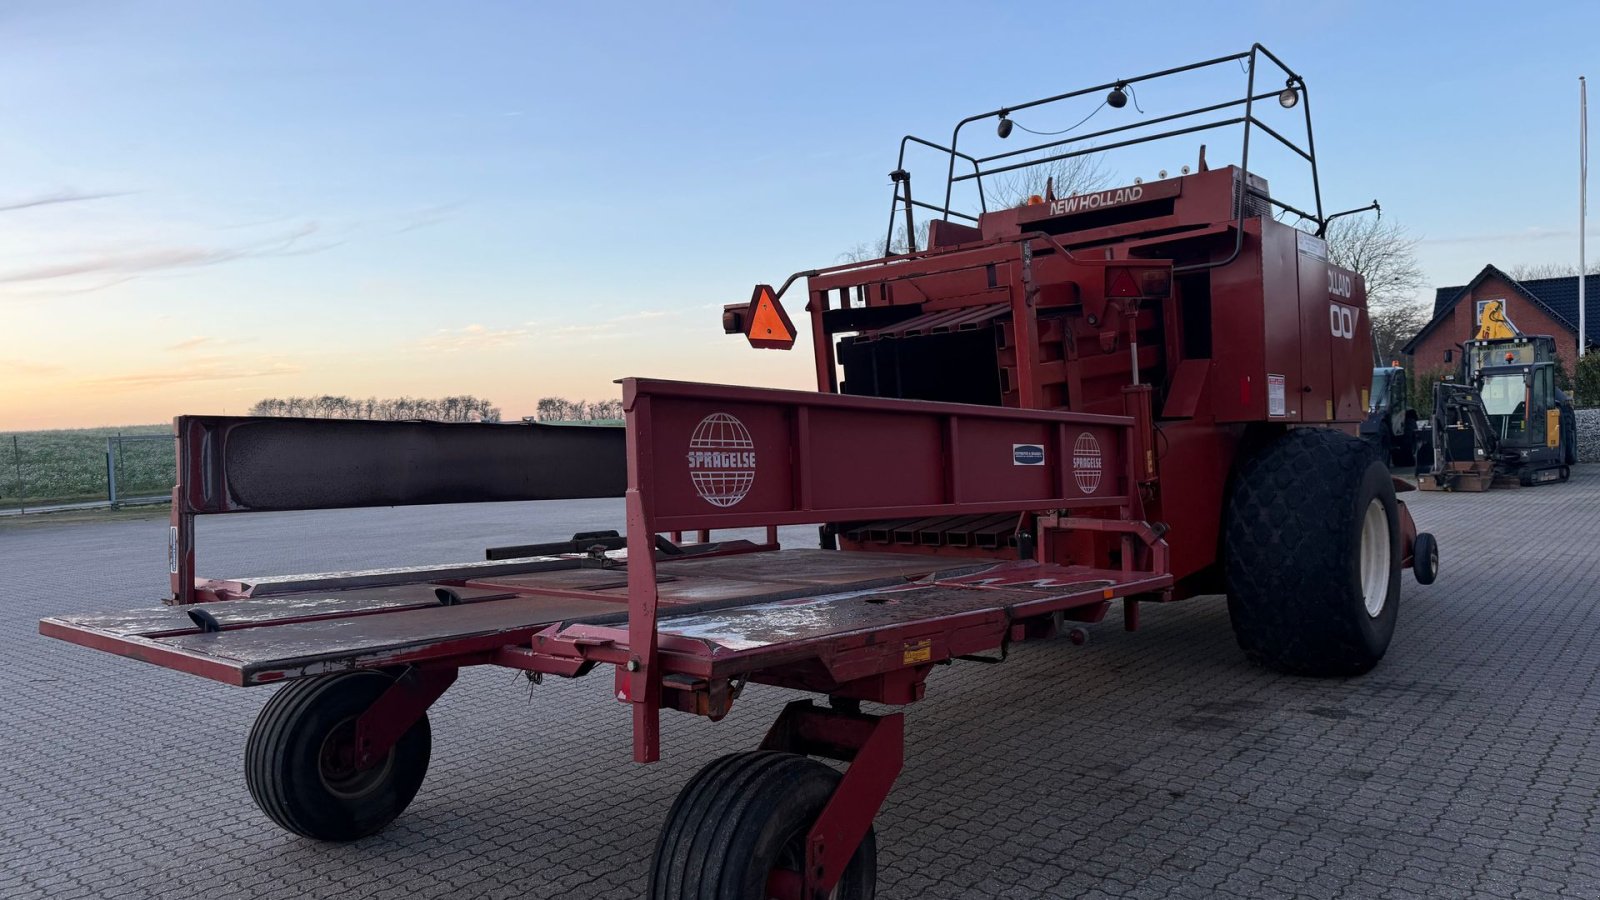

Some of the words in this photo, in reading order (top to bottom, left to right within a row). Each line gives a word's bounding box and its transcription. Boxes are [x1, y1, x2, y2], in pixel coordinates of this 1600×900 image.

[1050, 198, 1079, 216] NEW
[1080, 186, 1143, 211] HOLLAND
[688, 451, 756, 468] SPRAGELSE
[1073, 457, 1102, 469] SPRAGELSE
